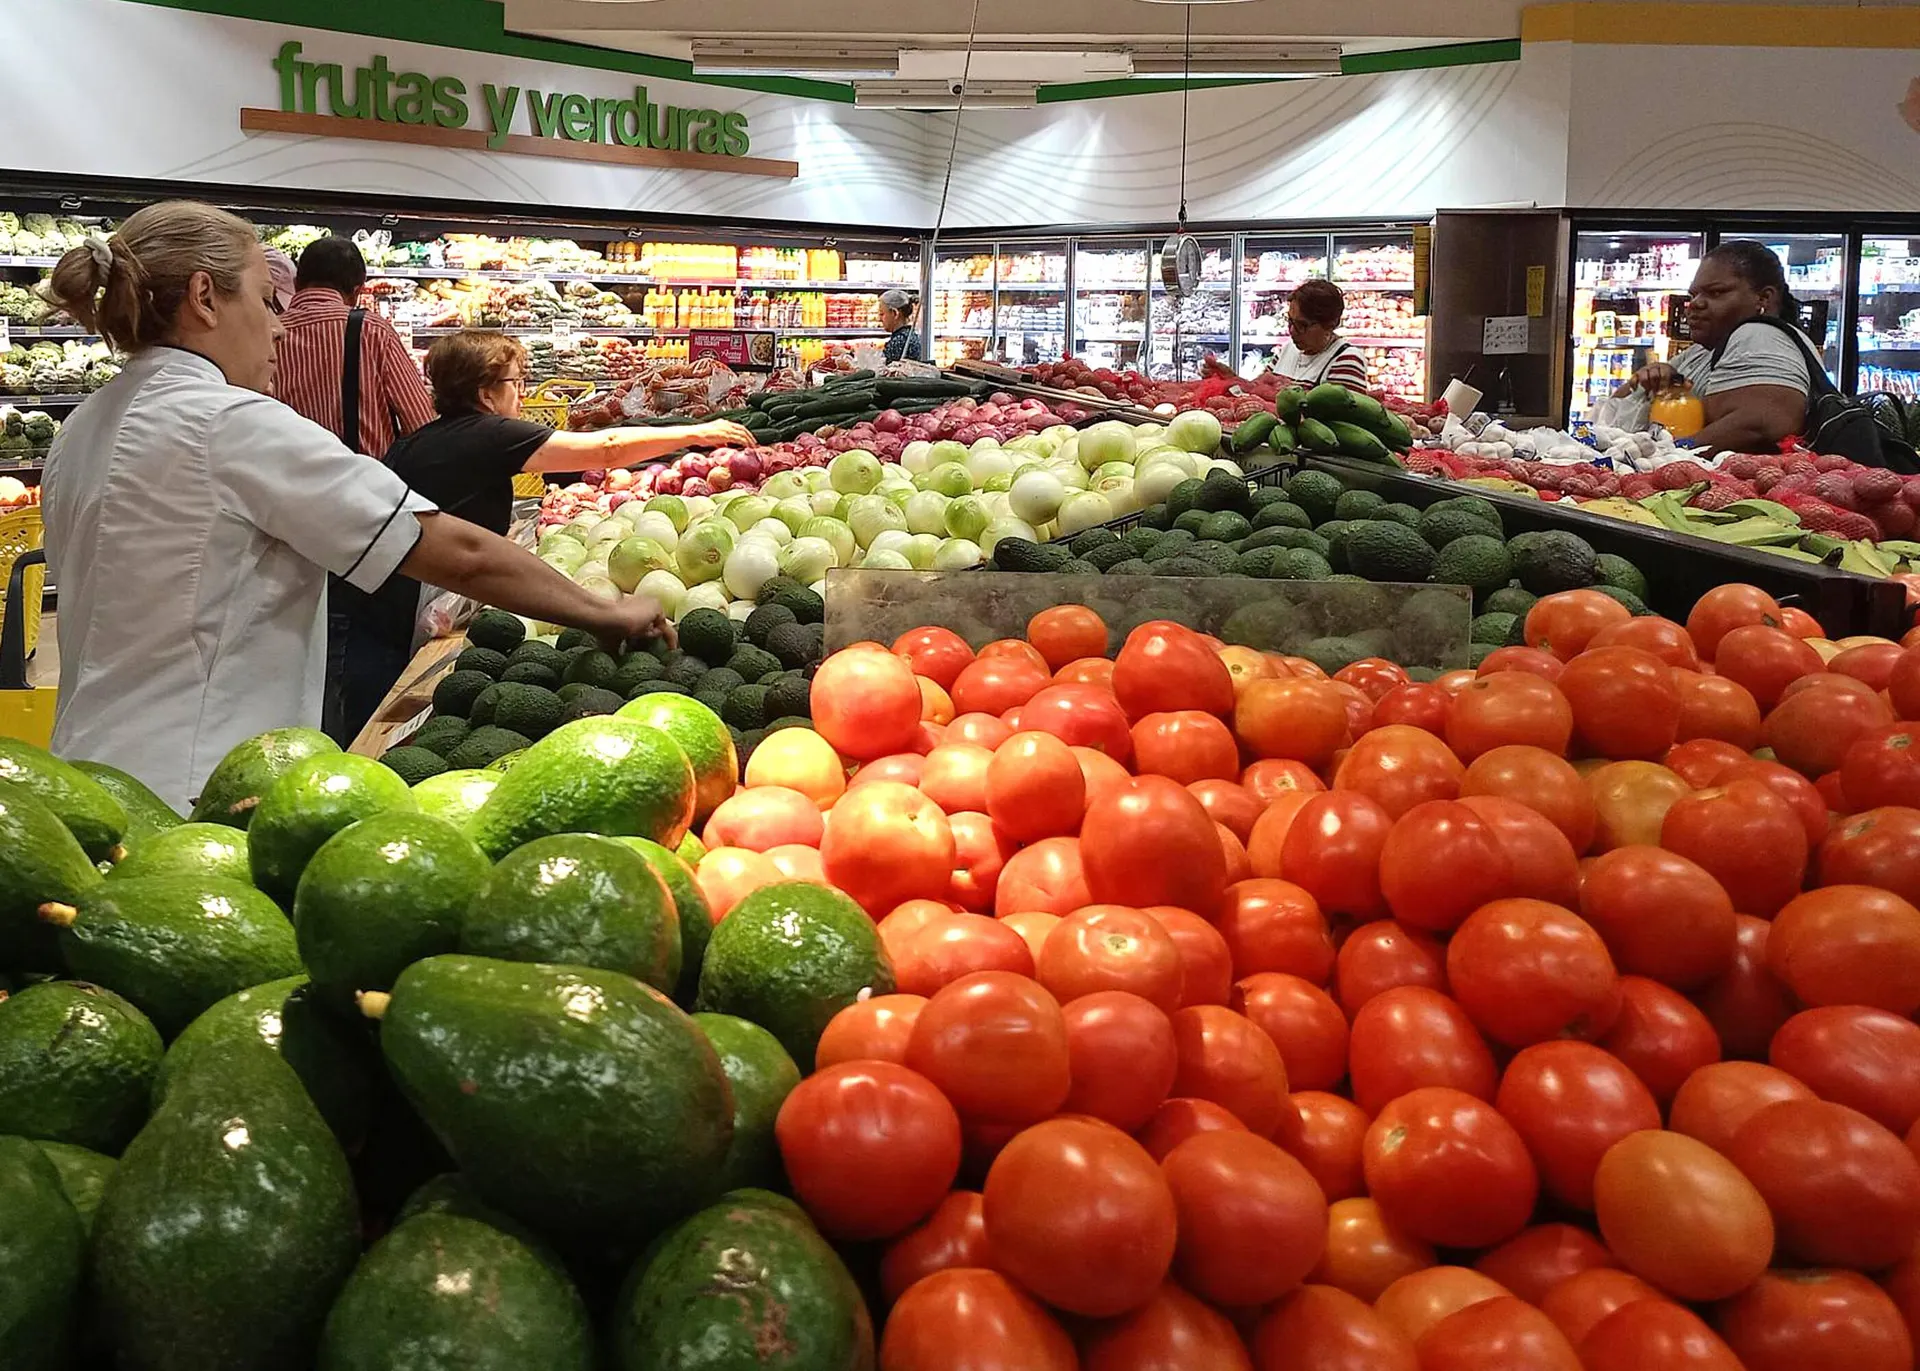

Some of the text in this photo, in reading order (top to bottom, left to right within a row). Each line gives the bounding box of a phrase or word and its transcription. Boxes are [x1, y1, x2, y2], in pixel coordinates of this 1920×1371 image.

[273, 41, 749, 155] frutas y verduras
